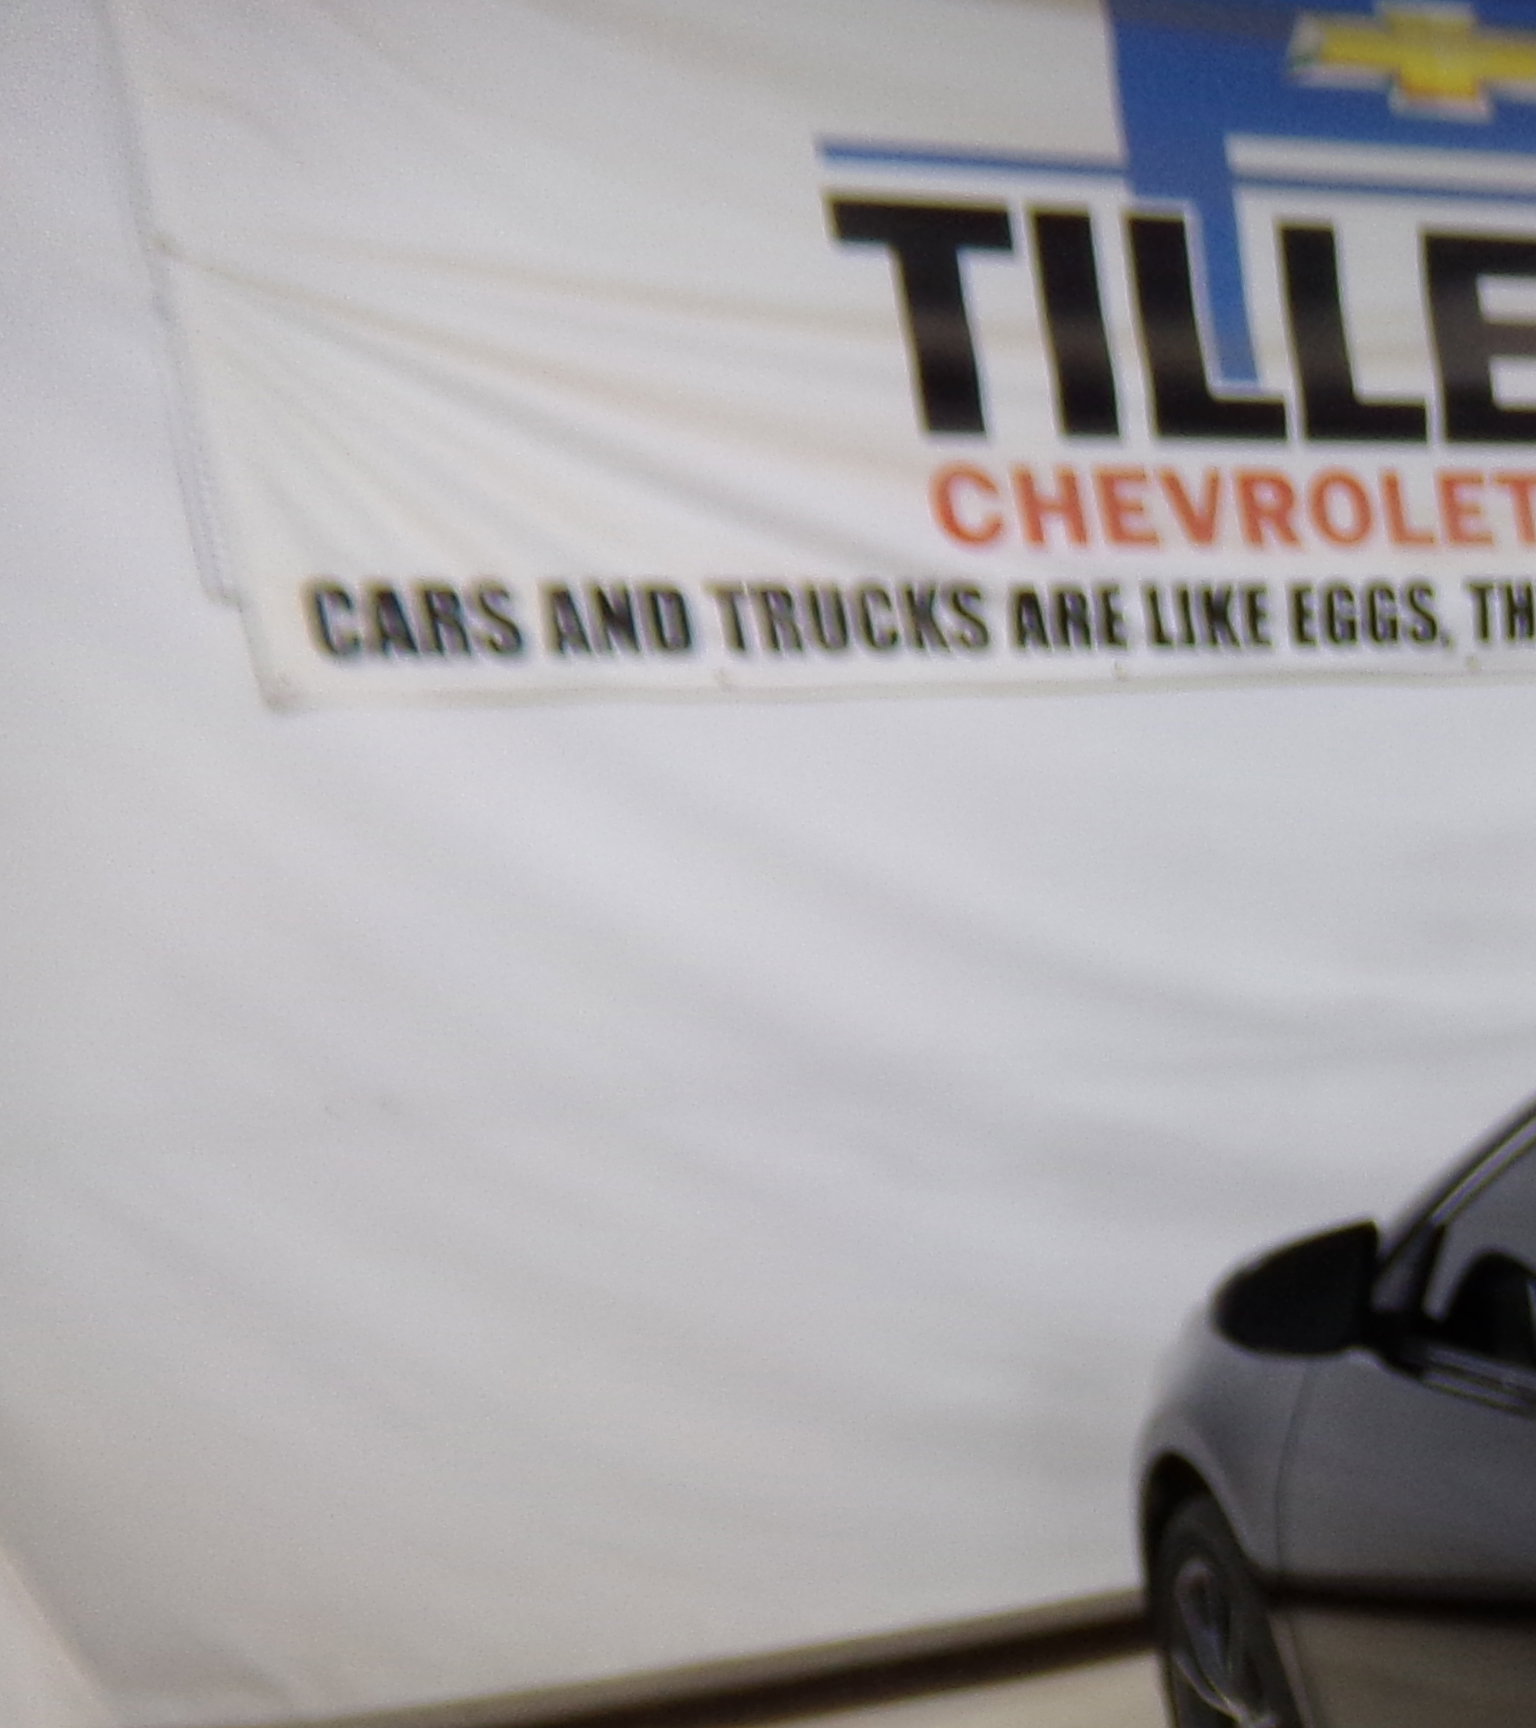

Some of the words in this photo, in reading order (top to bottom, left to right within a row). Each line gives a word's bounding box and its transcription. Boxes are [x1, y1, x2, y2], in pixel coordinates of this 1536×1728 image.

[305, 578, 524, 661] CARS
[537, 577, 693, 660] AND
[704, 577, 988, 656] TRUCKS
[1008, 580, 1129, 652] ARE
[1138, 580, 1275, 652] LIKE
[1284, 578, 1453, 650] EGGS,
